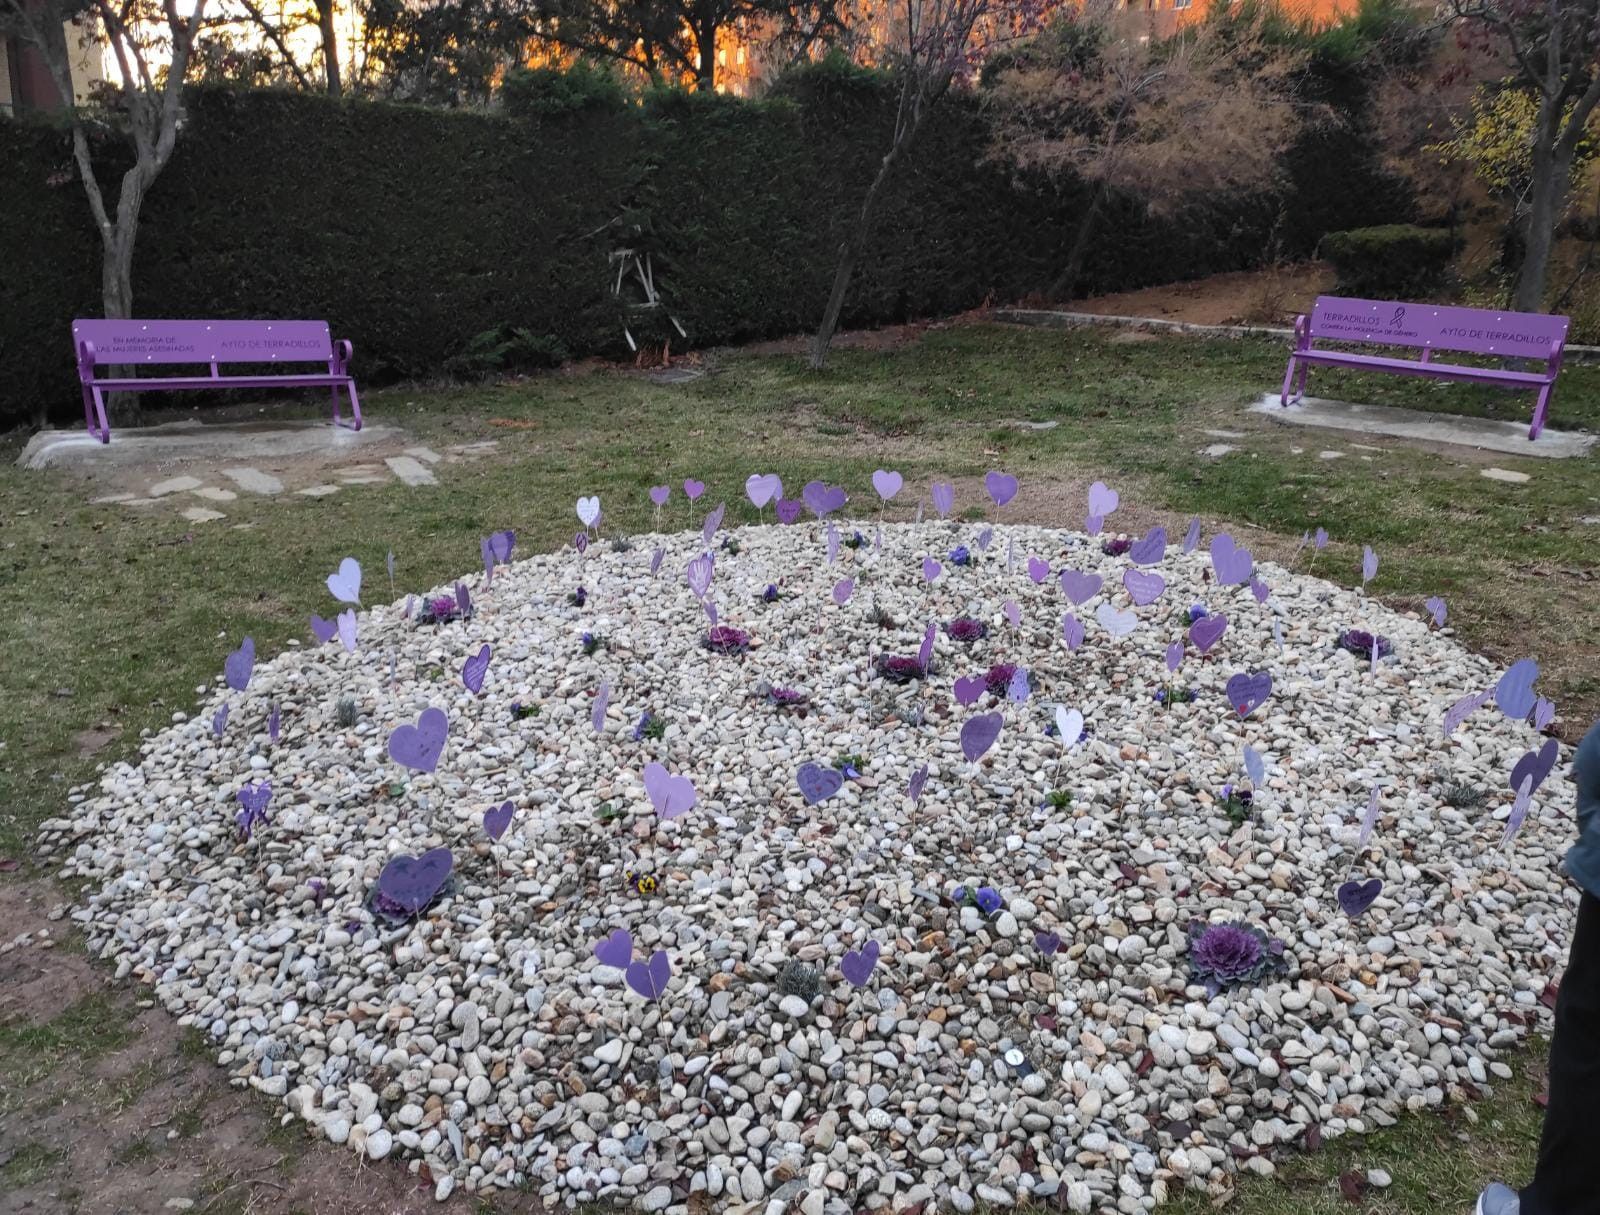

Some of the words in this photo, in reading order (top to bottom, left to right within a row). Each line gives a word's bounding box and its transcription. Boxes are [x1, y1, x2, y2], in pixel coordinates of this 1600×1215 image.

[1323, 312, 1380, 326] TERRADILLOS
[113, 336, 124, 344] EN
[165, 336, 176, 344] DE
[1439, 327, 1467, 337] AYTO
[1469, 329, 1484, 339] DE
[1486, 331, 1552, 345] TERRADILLOS
[221, 339, 246, 348] AYTO
[264, 339, 320, 348] TERRADILLOS
